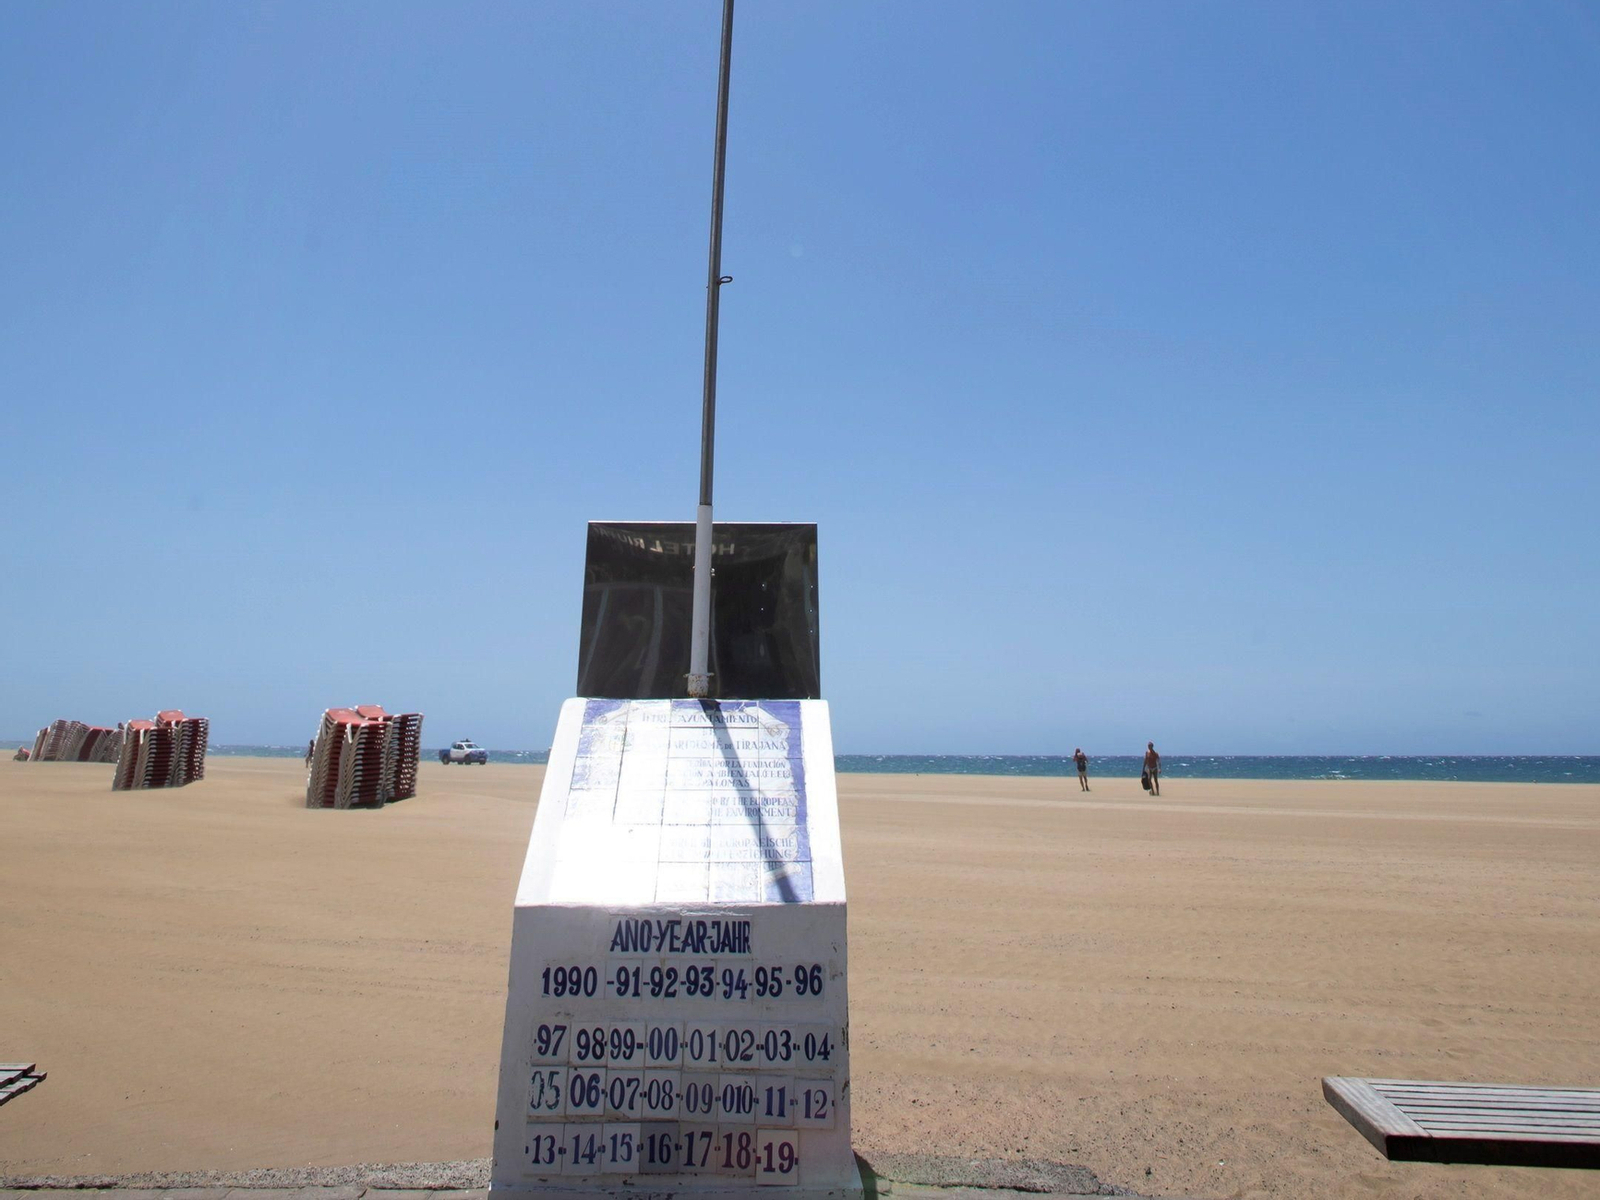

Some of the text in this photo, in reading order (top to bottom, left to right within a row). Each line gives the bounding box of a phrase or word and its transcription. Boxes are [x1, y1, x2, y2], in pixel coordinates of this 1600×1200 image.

[542, 963, 824, 1000] 1990 91 92 93 94 95 96
[537, 1024, 831, 1062] 97 98 99 00 01 02 03 04
[570, 1073, 601, 1108] 06
[609, 1077, 640, 1110] 07
[647, 1078, 674, 1111] 08
[685, 1082, 714, 1114] 09
[765, 1085, 786, 1118] 11
[803, 1089, 828, 1119] 12
[532, 1131, 795, 1173] 13 14 15 16 17 18 19
